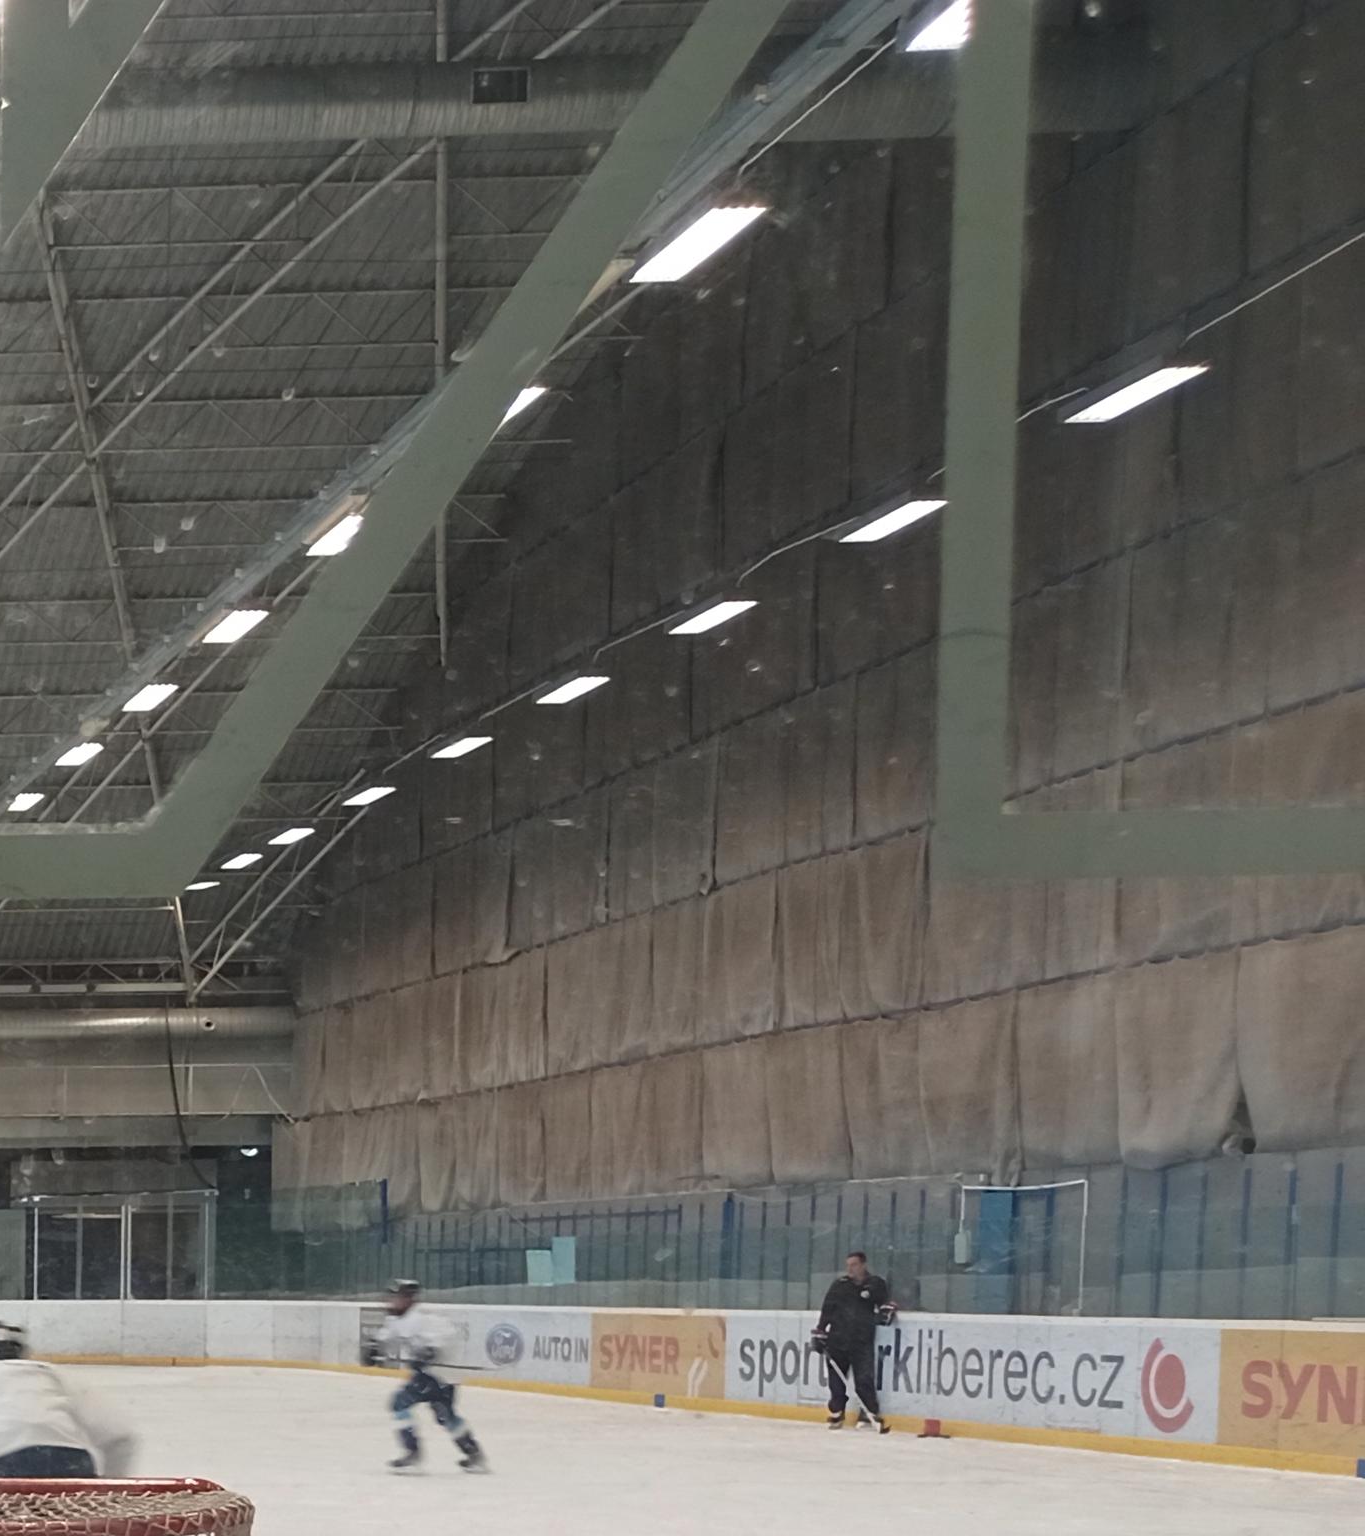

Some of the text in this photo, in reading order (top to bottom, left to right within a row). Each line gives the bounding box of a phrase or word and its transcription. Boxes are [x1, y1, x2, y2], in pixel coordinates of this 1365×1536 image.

[532, 1335, 589, 1363] AUTO IN
[599, 1334, 681, 1375] SYNER
[739, 1328, 1126, 1409] sportrkliberec.cz
[1241, 1359, 1365, 1426] SYN
